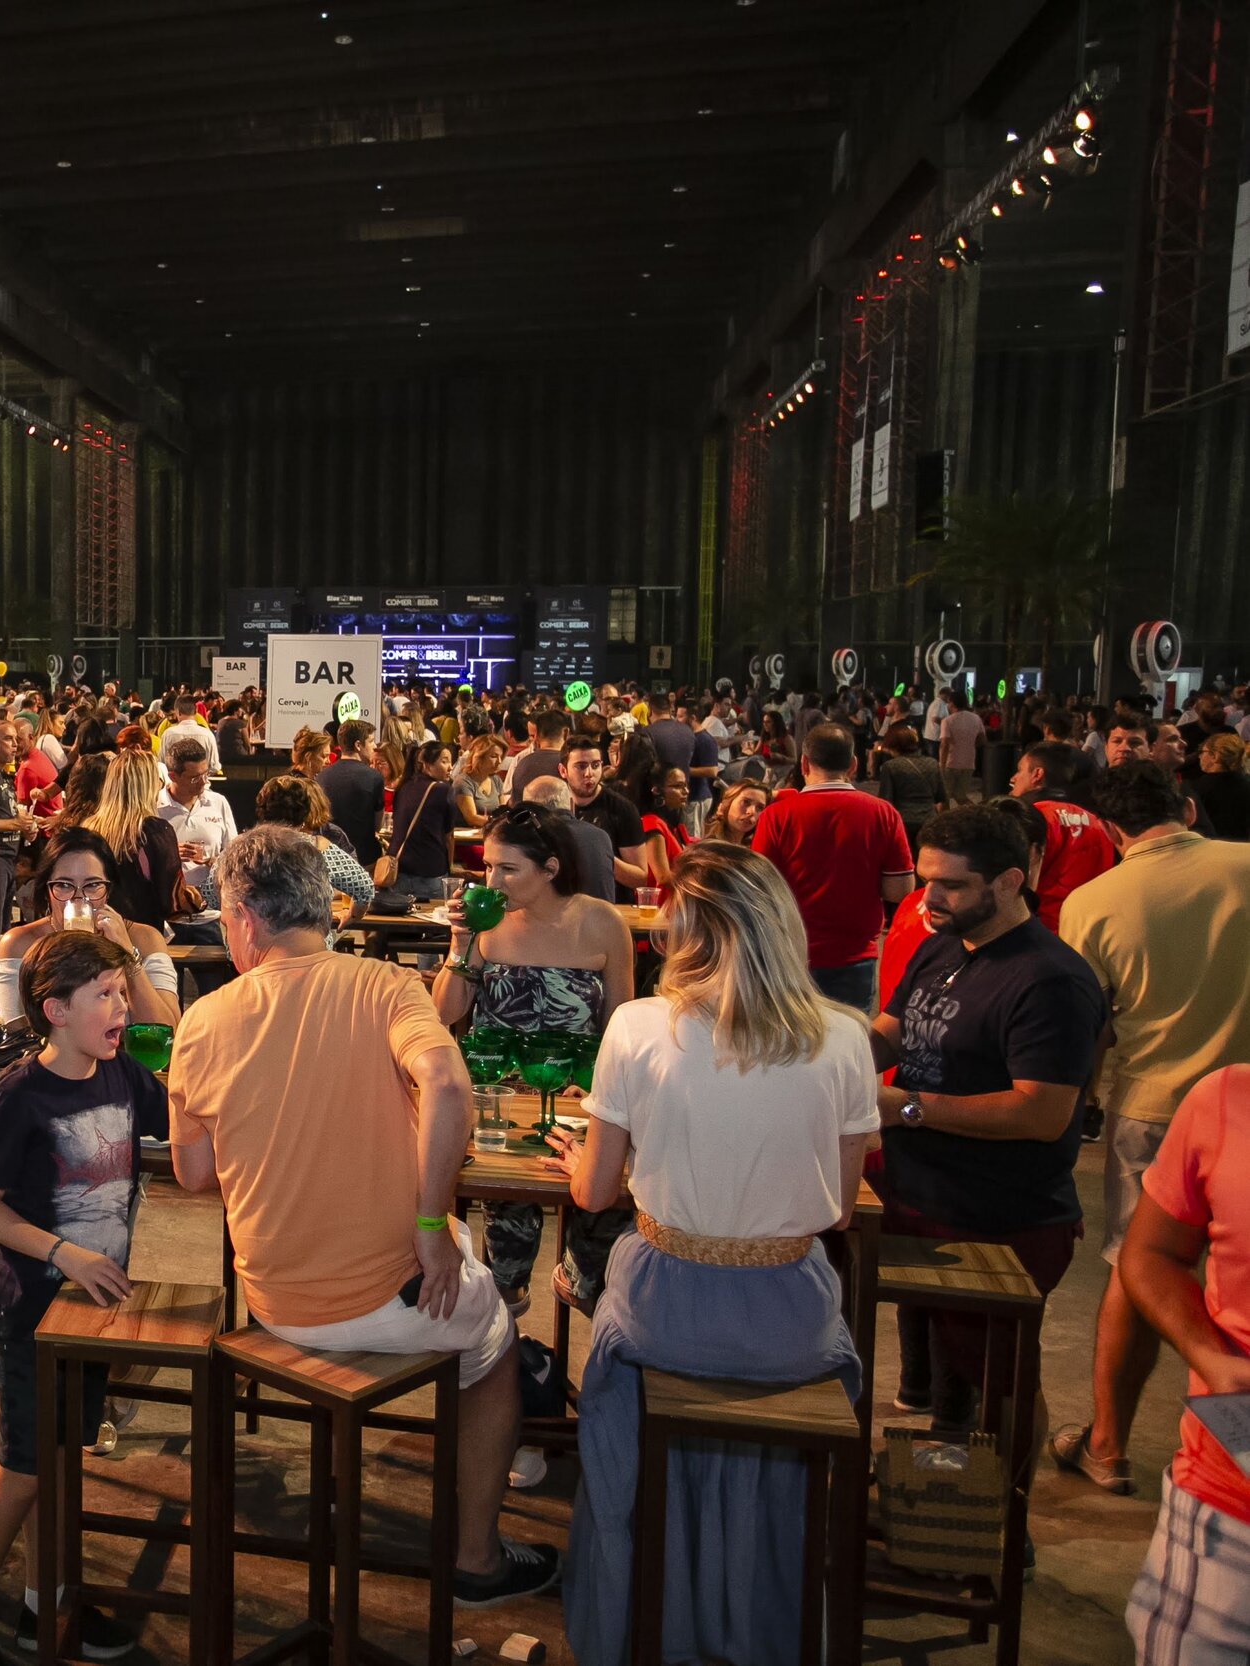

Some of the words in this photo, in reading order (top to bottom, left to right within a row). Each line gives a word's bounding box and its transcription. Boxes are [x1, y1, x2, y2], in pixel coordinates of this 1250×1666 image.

[382, 650, 417, 660] COMER
[425, 649, 458, 661] BEBER
[226, 662, 246, 671] BAR
[295, 661, 356, 685] BAR
[567, 685, 589, 703] CAIXA
[278, 698, 309, 708] Cerveja
[339, 699, 359, 717] CAIXA
